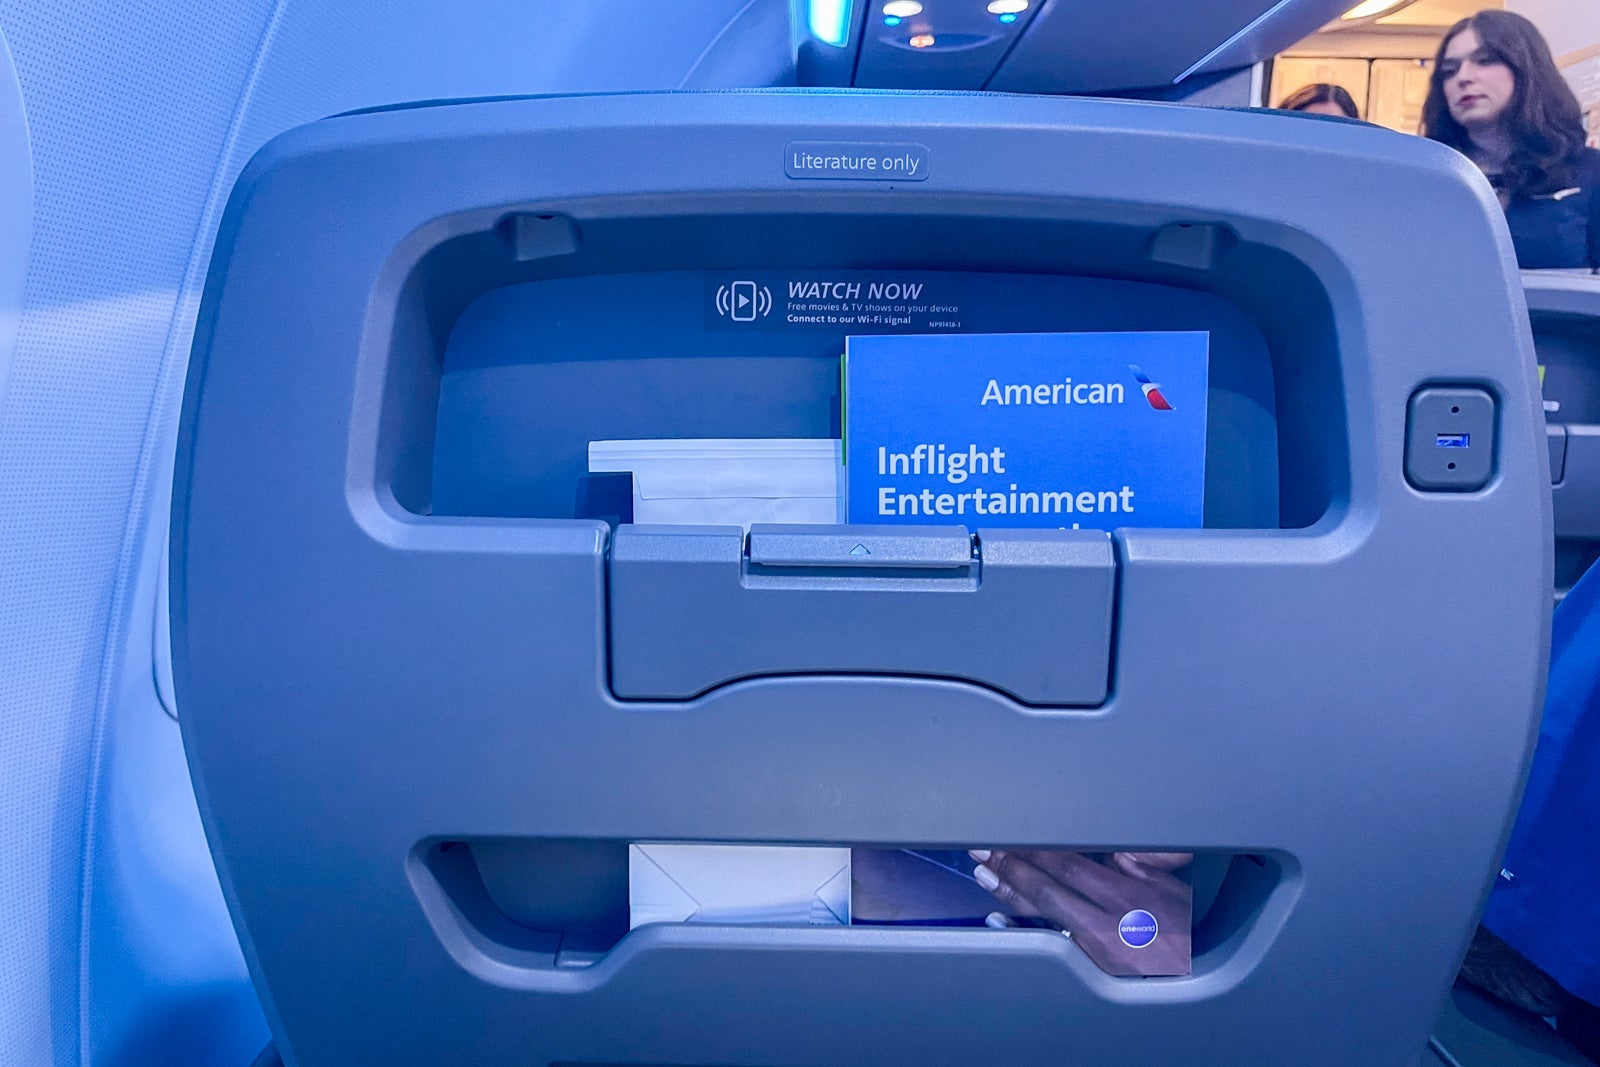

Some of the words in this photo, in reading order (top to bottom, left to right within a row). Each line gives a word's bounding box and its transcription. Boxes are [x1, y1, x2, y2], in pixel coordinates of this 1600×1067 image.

[793, 152, 877, 170] Literature
[881, 153, 920, 175] only
[788, 281, 861, 299] WATCH
[868, 282, 923, 300] NOW
[787, 302, 807, 311] Free
[809, 302, 840, 312] movies
[842, 302, 849, 312] &
[851, 303, 863, 312] TV
[865, 303, 892, 312] shows
[908, 305, 928, 315] your
[930, 304, 959, 313] device
[787, 314, 825, 323] Connect
[827, 315, 837, 323] to
[857, 315, 882, 324] Wi-Fi
[884, 315, 911, 326] signal
[980, 377, 1125, 406] American
[878, 443, 1006, 484] Inflight
[878, 483, 1135, 516] Entertainment
[1120, 924, 1156, 933] oneworld
